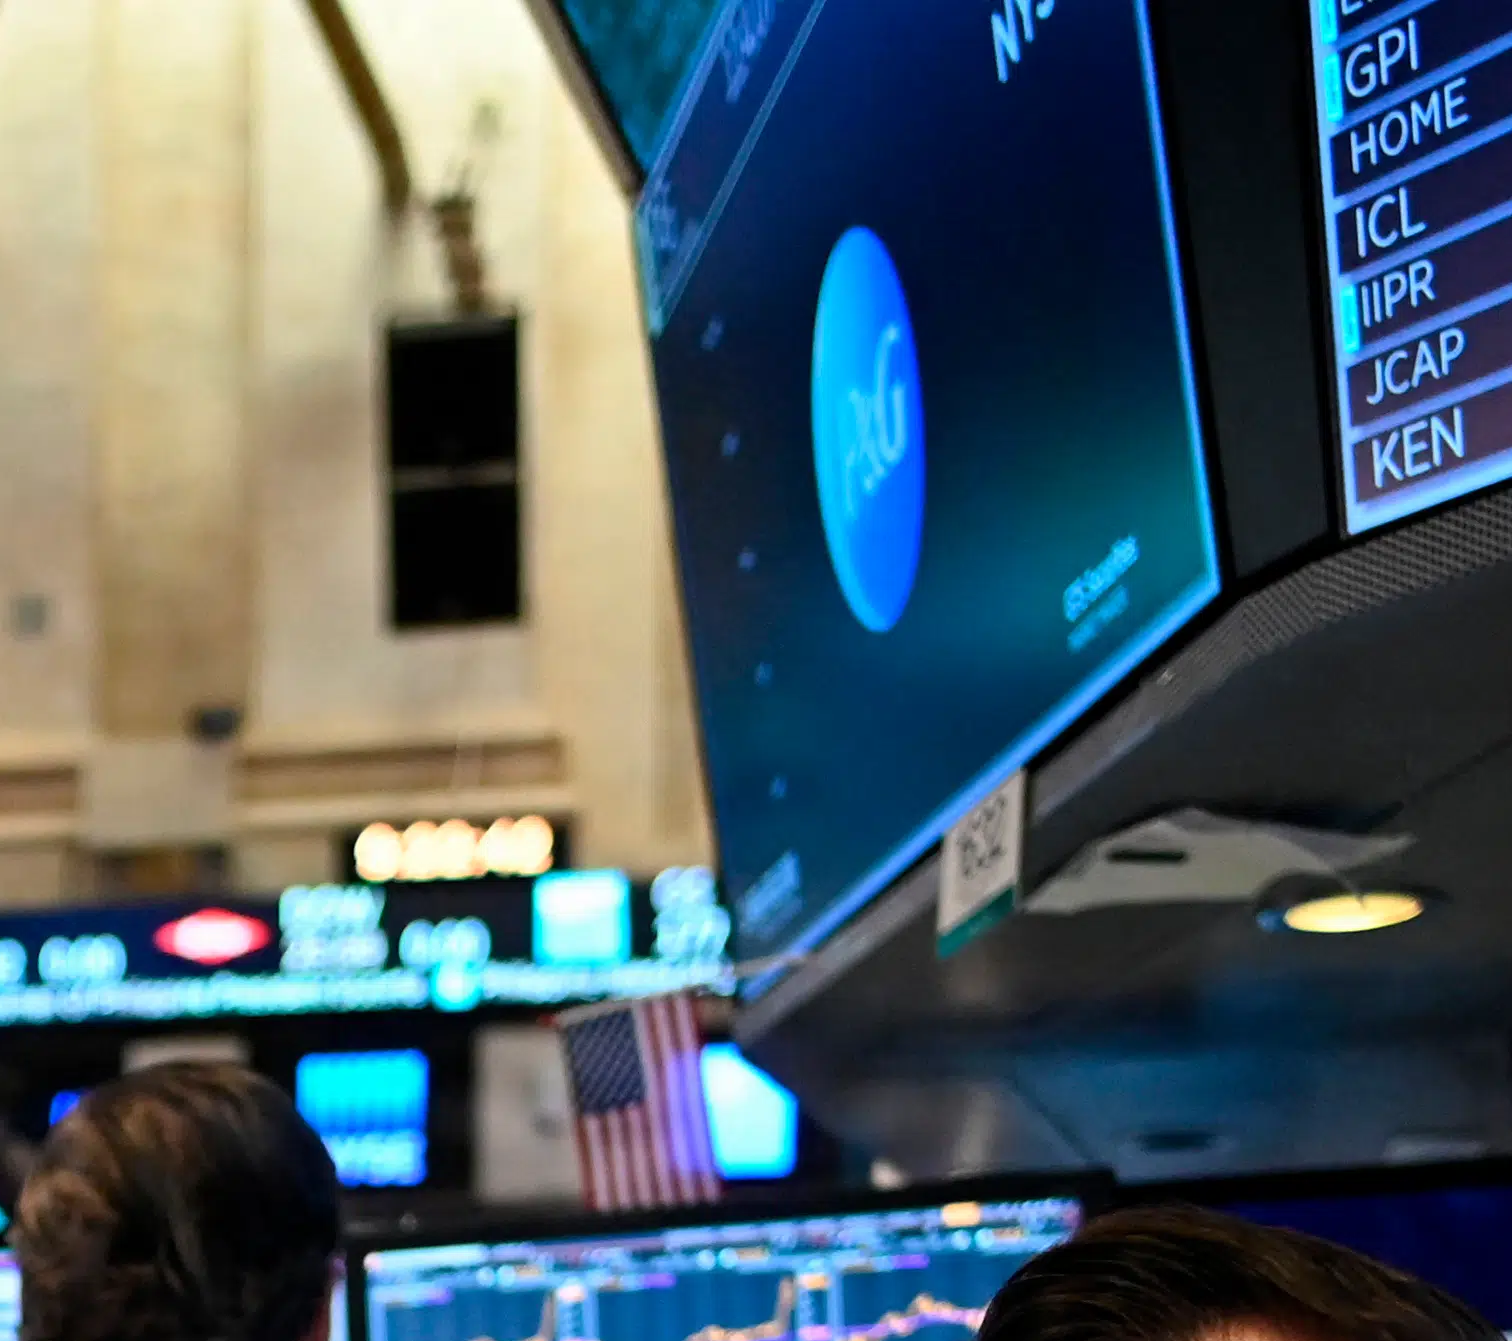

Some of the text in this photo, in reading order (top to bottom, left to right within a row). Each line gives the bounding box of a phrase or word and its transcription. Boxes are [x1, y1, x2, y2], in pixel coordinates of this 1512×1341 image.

[1344, 18, 1419, 98] GPI
[1350, 77, 1469, 175] HOME
[1355, 187, 1426, 258] ICL
[1361, 259, 1436, 328] IIPR
[1366, 327, 1465, 405] JCAP
[1371, 407, 1465, 488] KEN
